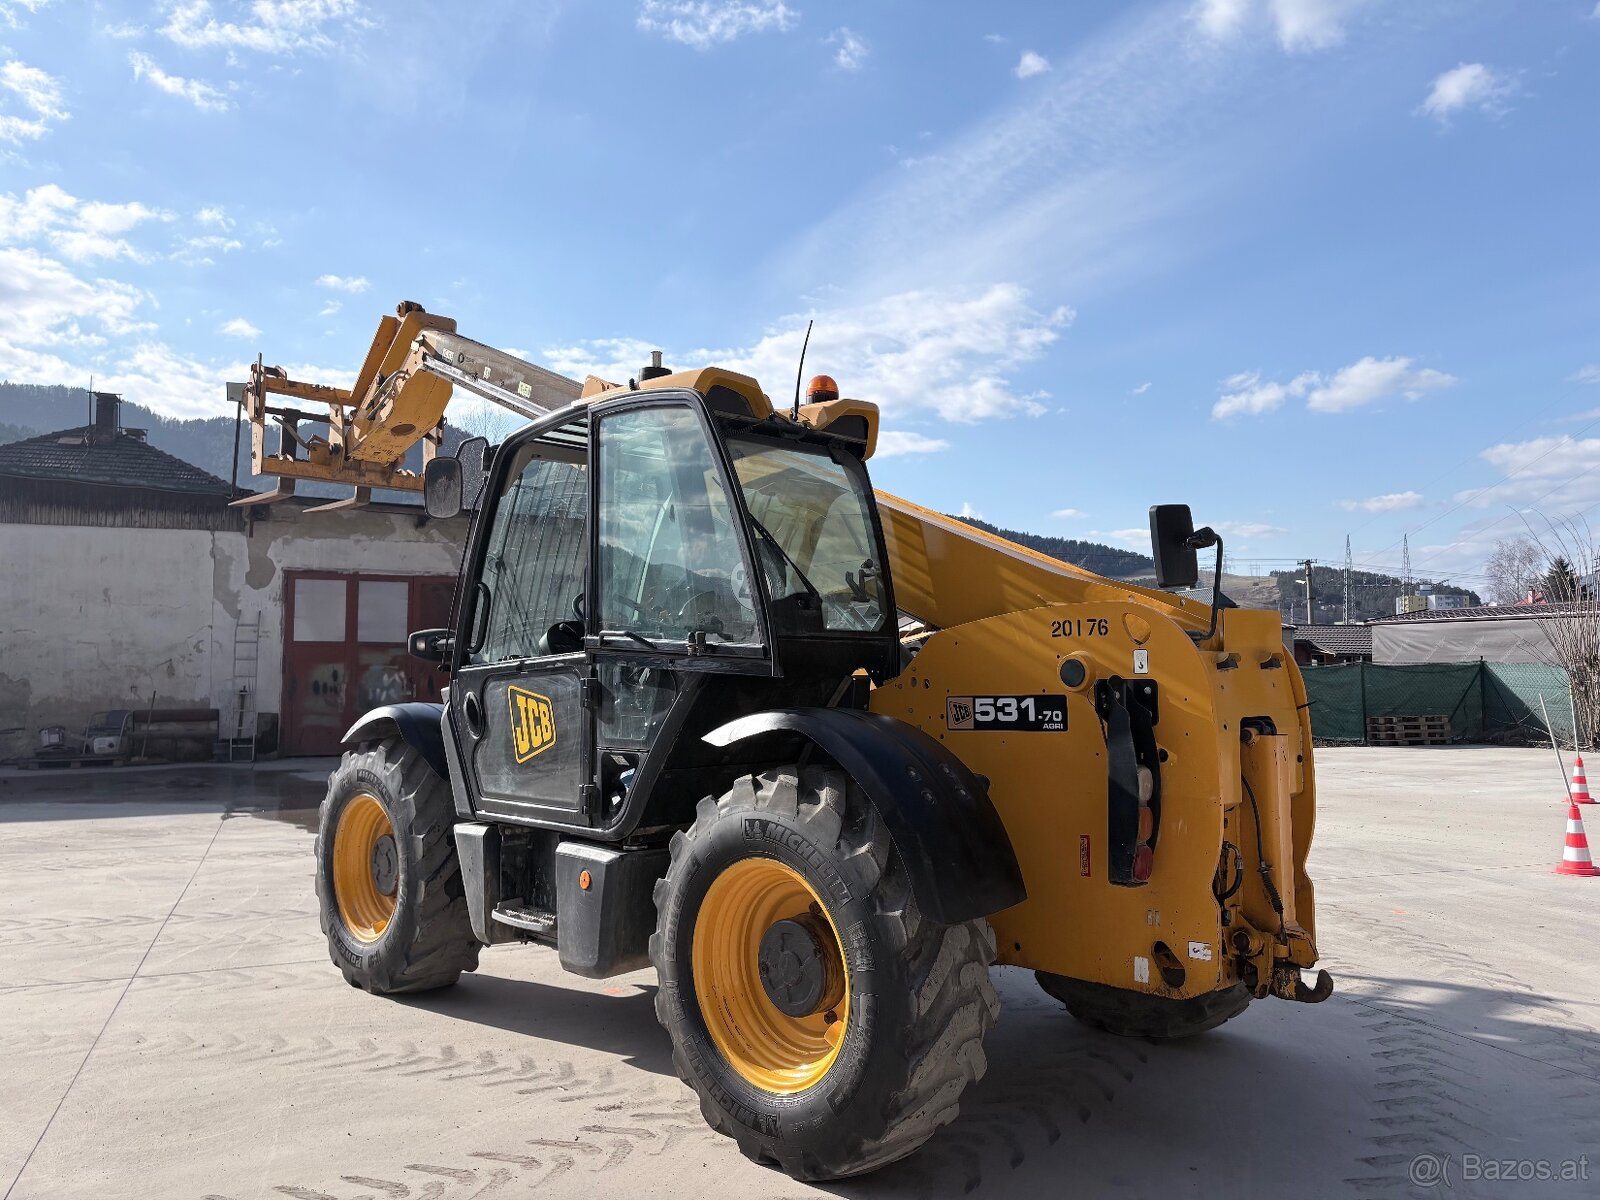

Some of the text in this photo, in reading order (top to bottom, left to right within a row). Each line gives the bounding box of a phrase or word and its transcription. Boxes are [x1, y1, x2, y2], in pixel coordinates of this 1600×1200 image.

[1051, 618, 1109, 638] 20176
[515, 693, 553, 755] JCB
[953, 703, 972, 722] JCB
[765, 821, 855, 903] MICHELIN
